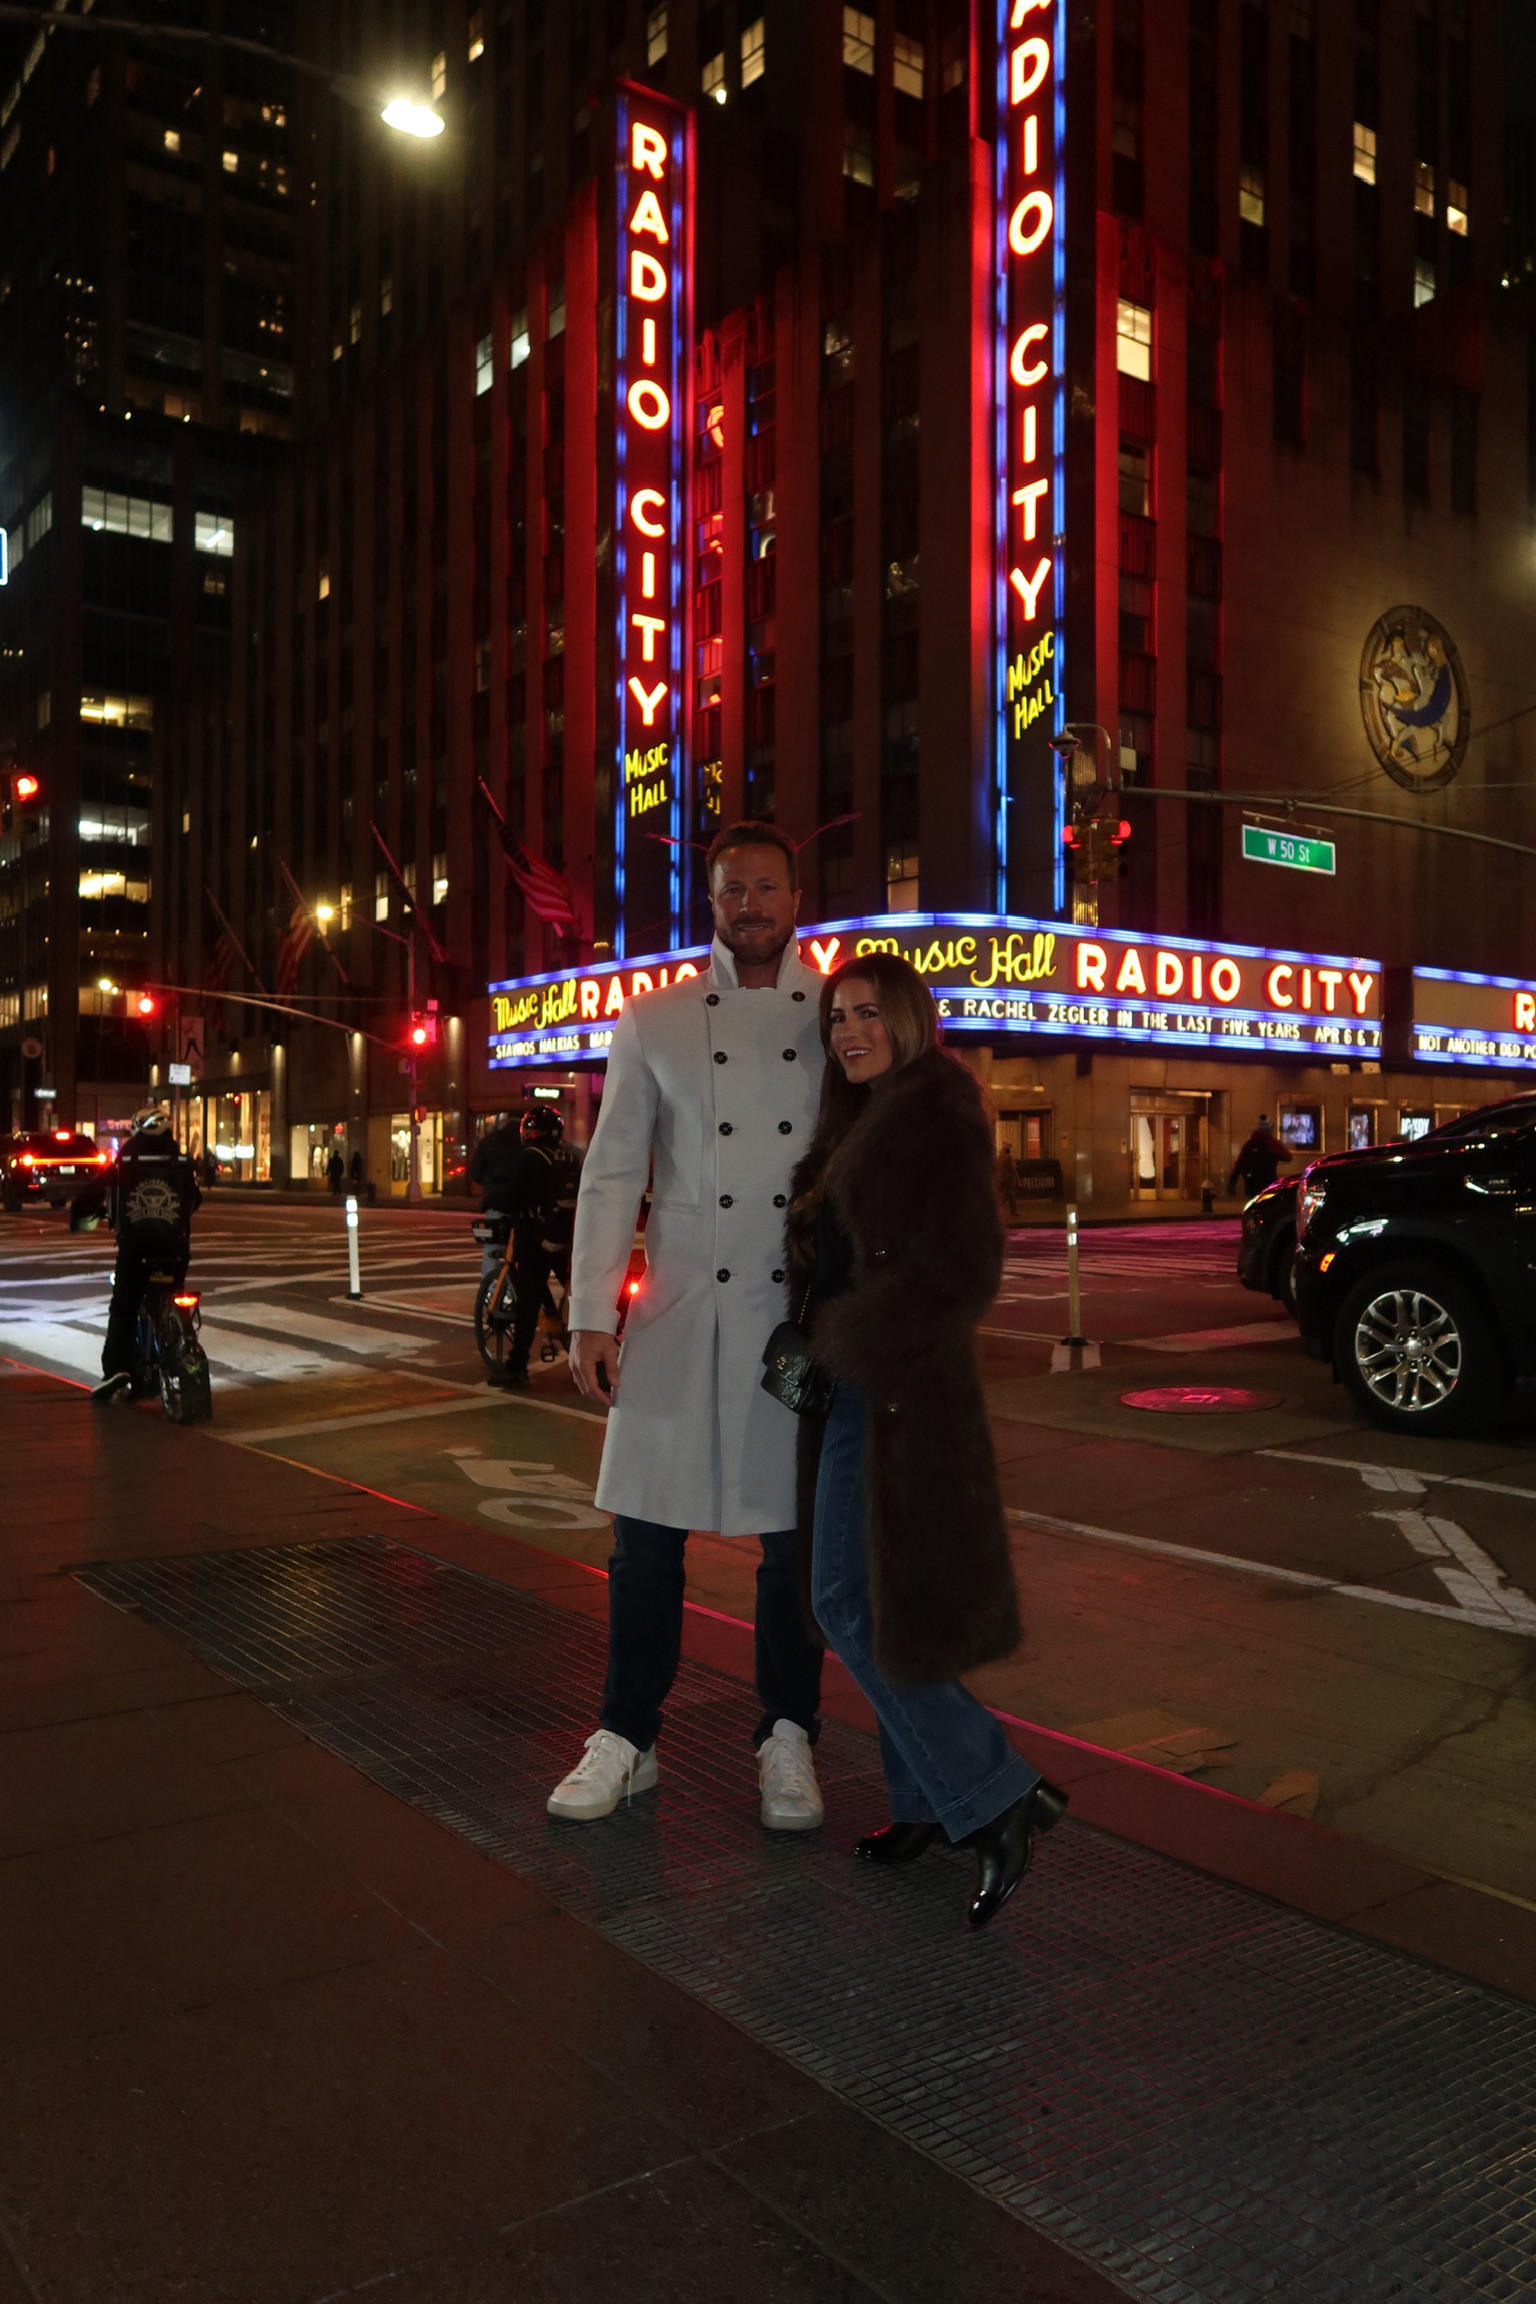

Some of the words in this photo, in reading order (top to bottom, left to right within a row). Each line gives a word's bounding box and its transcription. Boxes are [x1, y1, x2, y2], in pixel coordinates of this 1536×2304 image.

[629, 121, 670, 430] RADIO
[1010, 323, 1052, 621] CITY
[628, 487, 669, 726] CITY
[1268, 838, 1276, 855] W
[1280, 841, 1294, 859] 50
[1299, 845, 1310, 862] St
[970, 933, 1057, 988] Hall
[1076, 942, 1241, 1003] RADIO
[1267, 963, 1374, 1015] CITY
[493, 993, 539, 1032] Music
[533, 977, 579, 1030] Hall
[963, 998, 1037, 1021] RACHEL
[1048, 1004, 1109, 1026] ZEGLER
[1117, 1010, 1133, 1029] IN
[1142, 1011, 1169, 1031] THE
[1177, 1014, 1213, 1034] LAST
[1221, 1018, 1251, 1037] FIVE
[1257, 1022, 1301, 1040] YEARS
[1314, 1026, 1340, 1044] APR
[1343, 1029, 1353, 1045] 6
[1515, 991, 1536, 1032] R
[495, 1040, 535, 1060] STAVROS
[1418, 1034, 1441, 1052] NOT
[1447, 1036, 1497, 1056] ANOTHER
